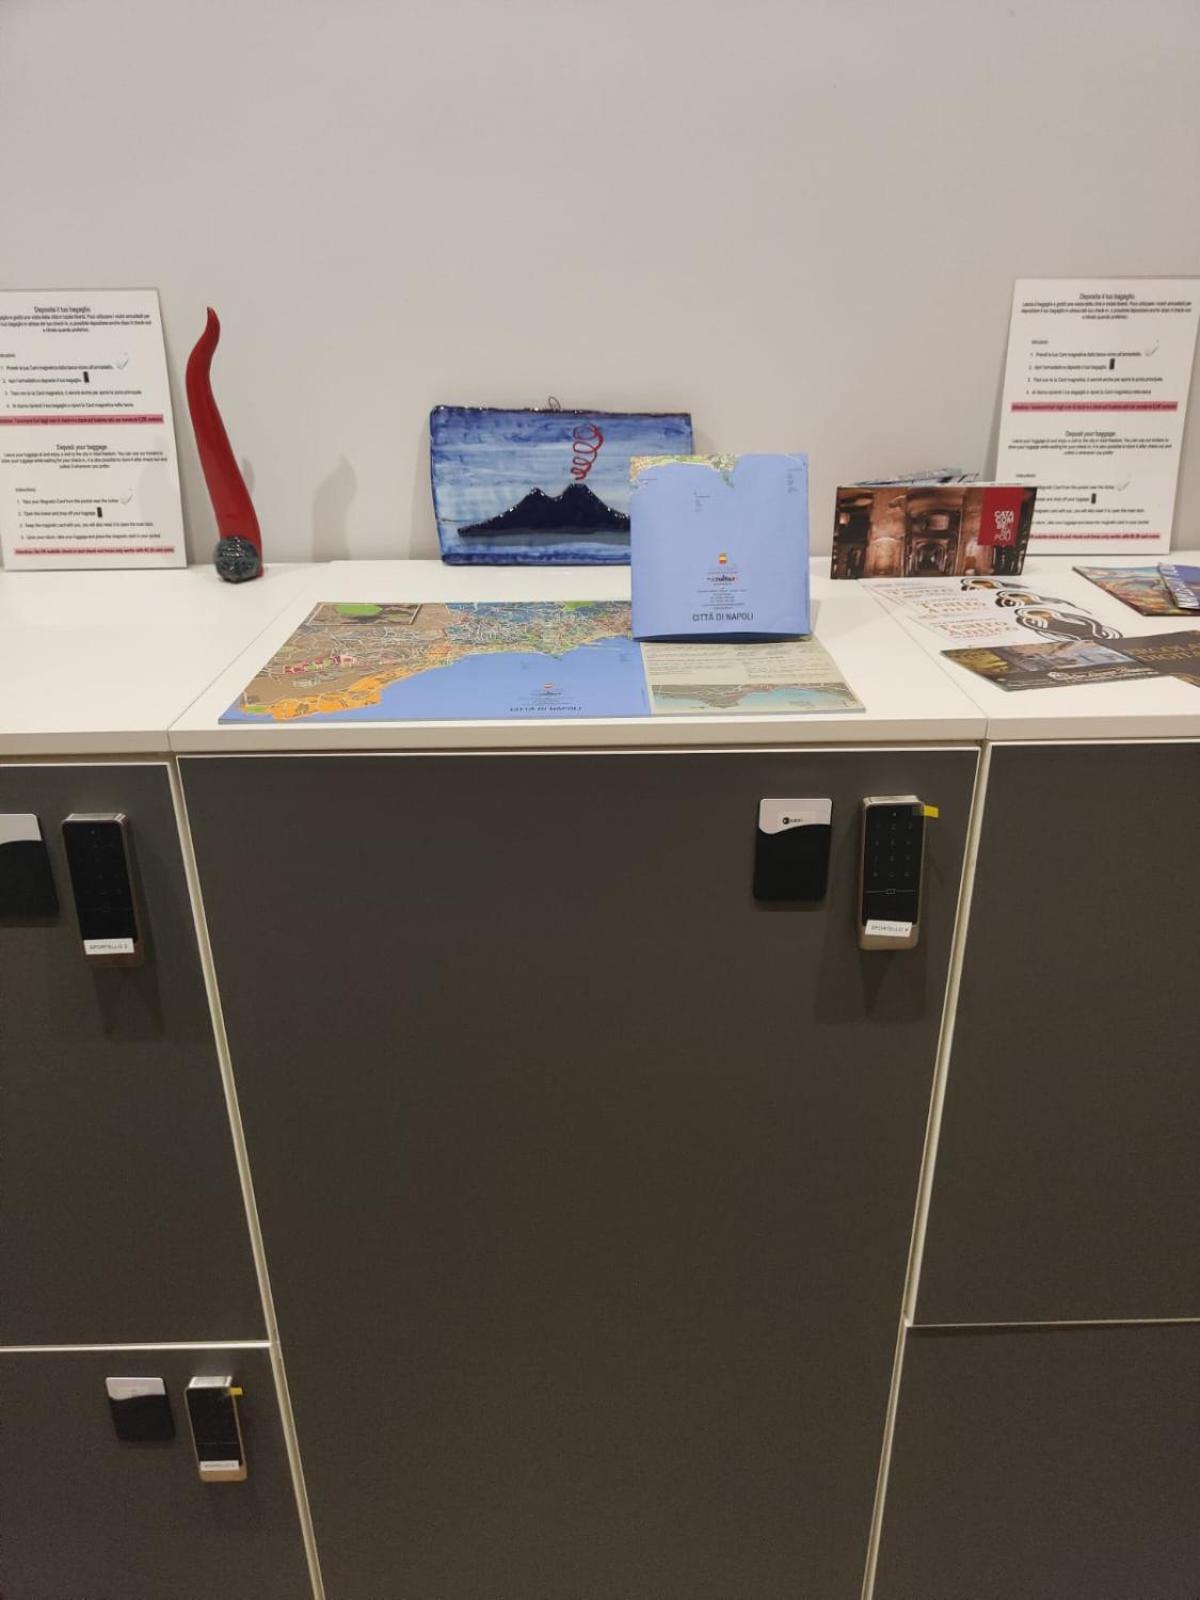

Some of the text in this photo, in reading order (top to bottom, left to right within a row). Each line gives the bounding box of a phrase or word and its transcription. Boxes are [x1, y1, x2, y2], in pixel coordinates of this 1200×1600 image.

[994, 510, 1015, 518] CATA
[692, 612, 754, 622] CITTÀ DI NAPOLI
